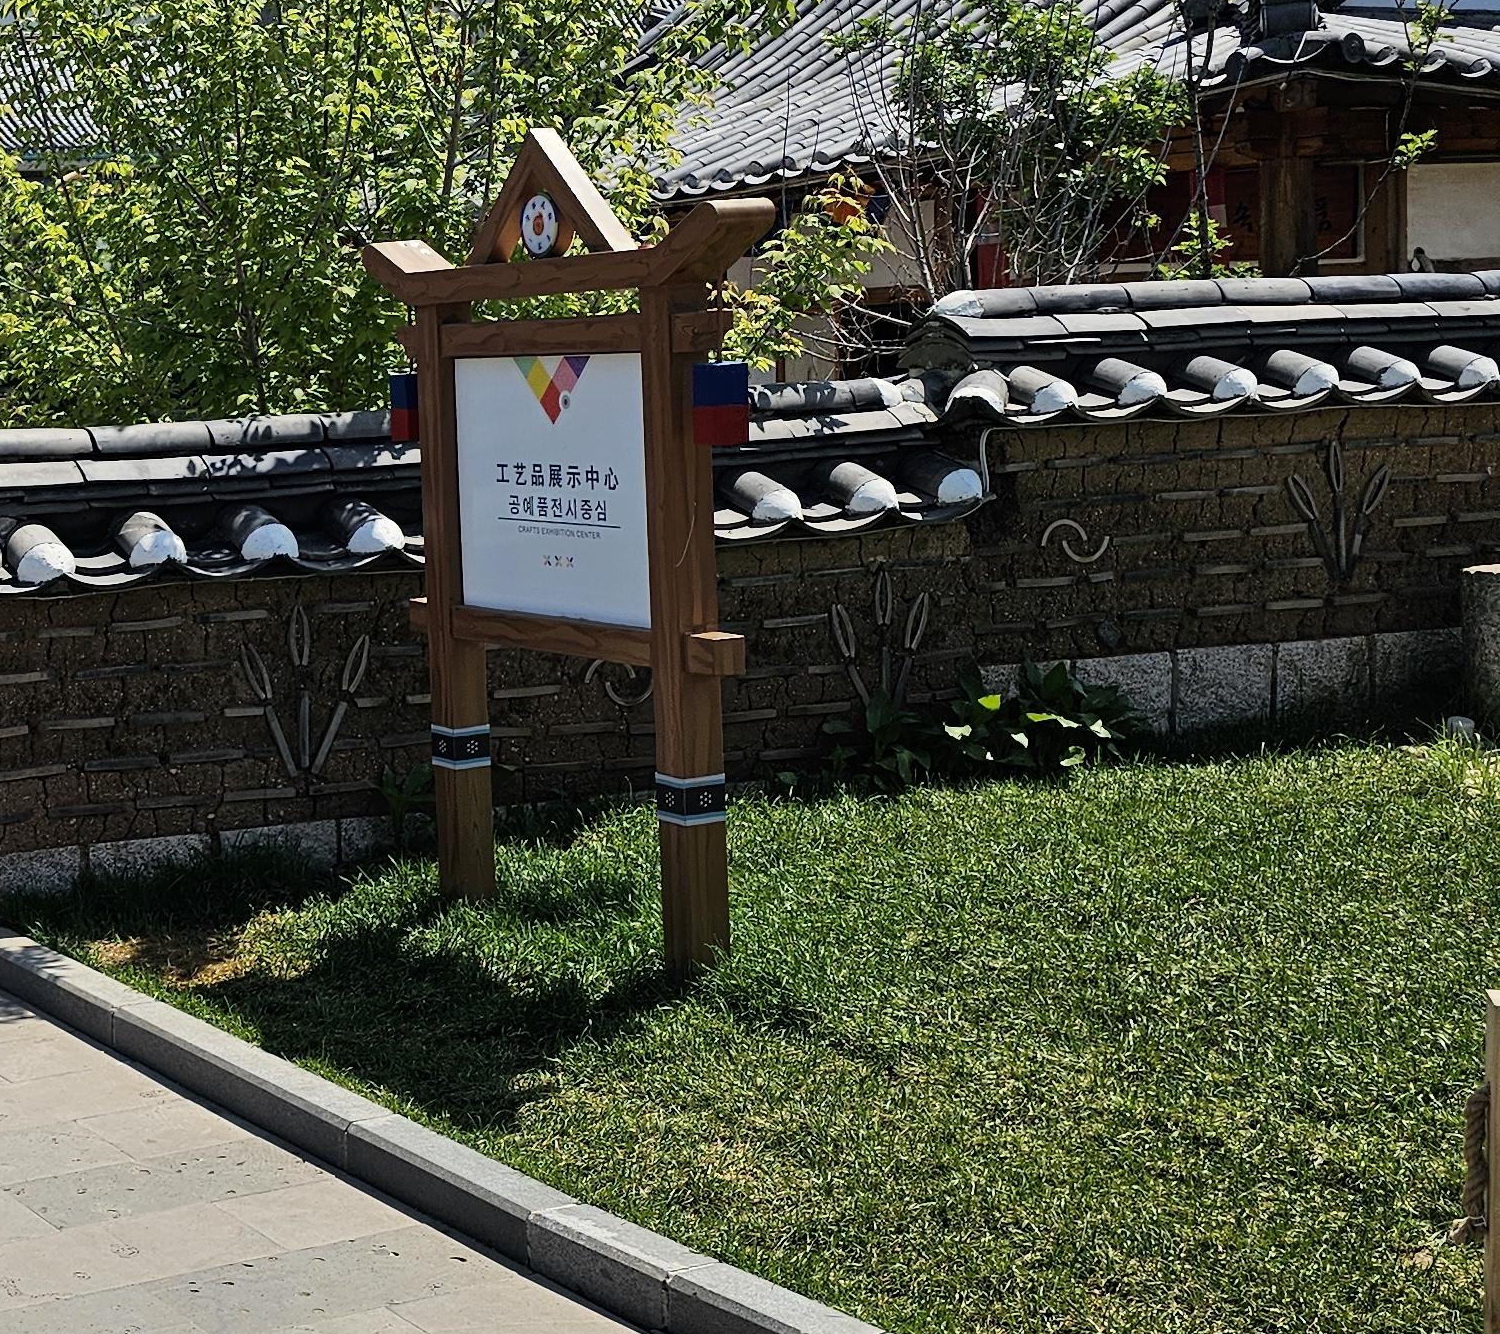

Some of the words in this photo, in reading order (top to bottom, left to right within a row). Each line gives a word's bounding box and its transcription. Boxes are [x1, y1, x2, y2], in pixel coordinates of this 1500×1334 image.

[496, 462, 619, 491] 工艺品展示中心
[508, 494, 607, 522] 공예품전시중심
[517, 525, 540, 534] CRAFTS
[541, 527, 575, 538] EXHIBITION
[576, 530, 602, 540] CENTER
